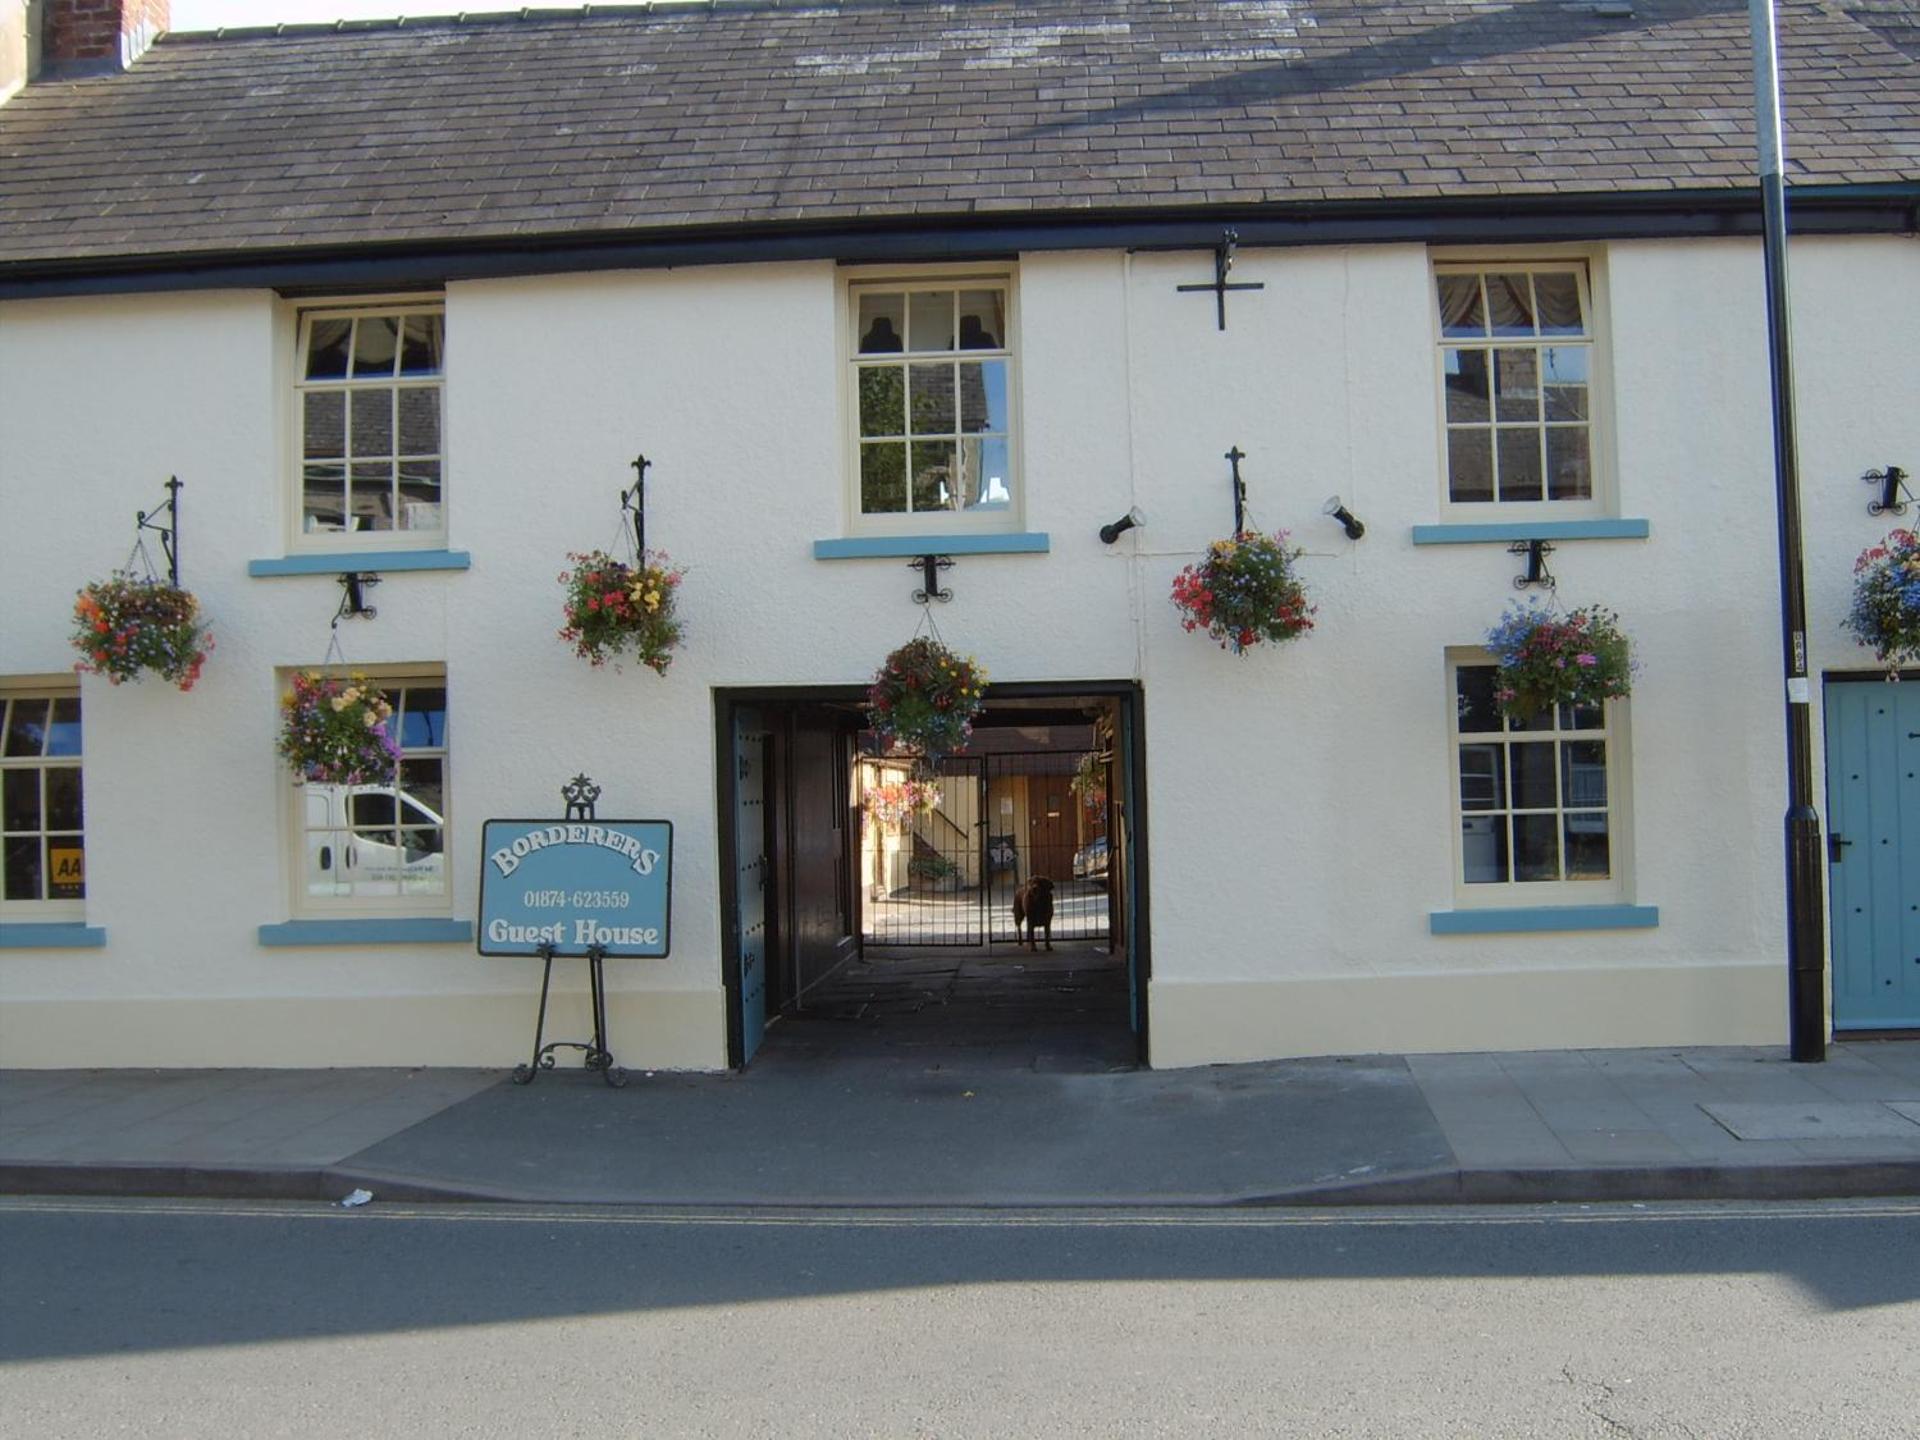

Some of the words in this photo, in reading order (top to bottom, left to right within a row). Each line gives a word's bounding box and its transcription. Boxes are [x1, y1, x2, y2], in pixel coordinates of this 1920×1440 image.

[491, 824, 660, 878] BORDERERS
[56, 857, 81, 877] AA
[488, 918, 566, 944] Guest
[574, 919, 659, 945] House
